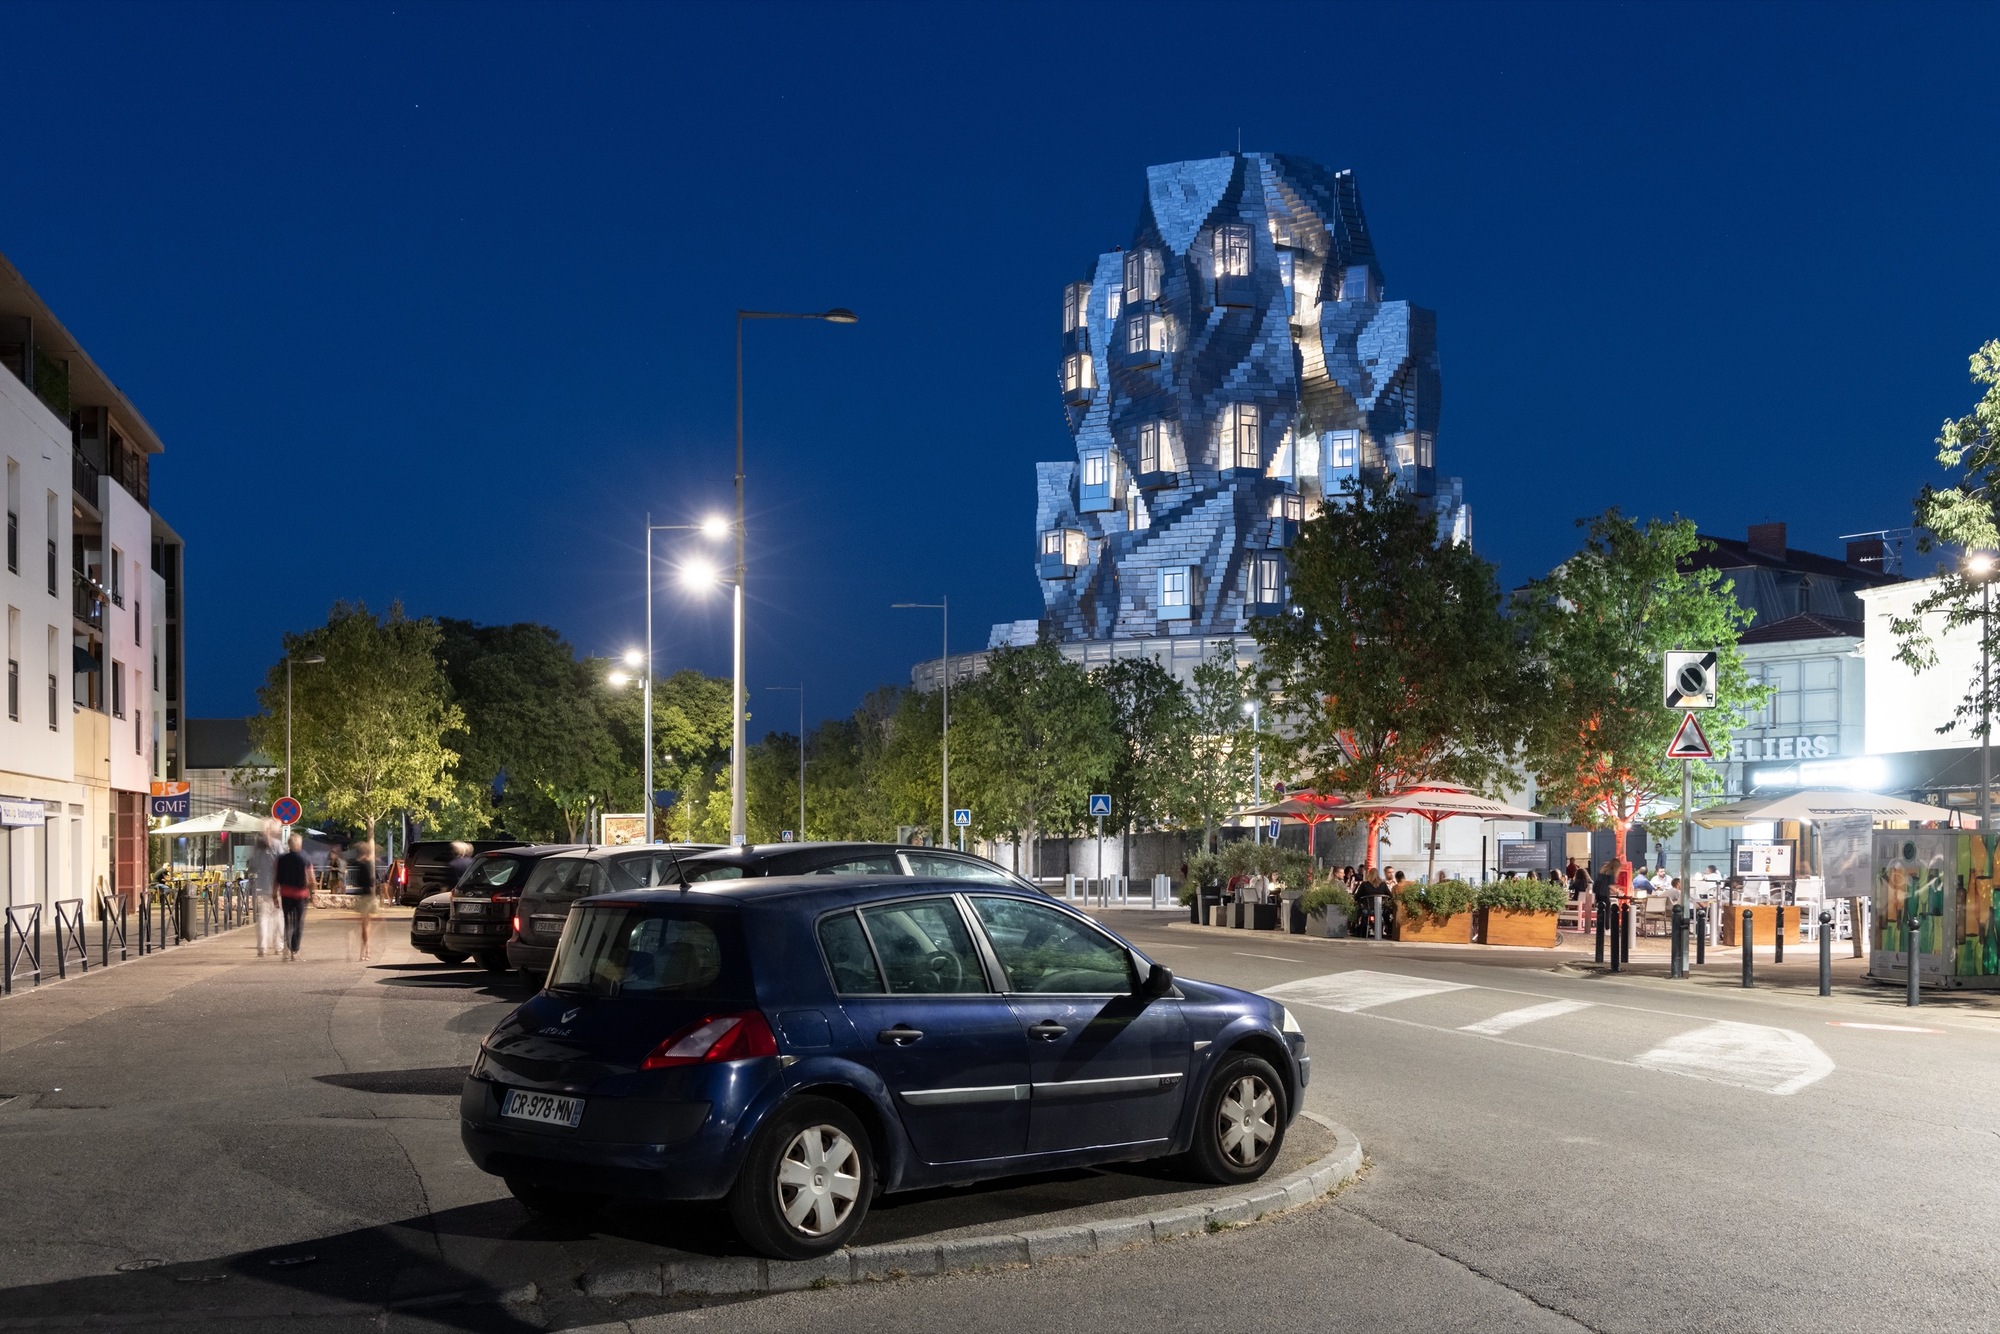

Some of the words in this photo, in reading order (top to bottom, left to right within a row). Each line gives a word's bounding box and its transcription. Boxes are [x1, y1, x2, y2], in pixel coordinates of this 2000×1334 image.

[1708, 736, 1829, 761] ELIERS
[154, 800, 187, 813] GMF
[511, 1093, 575, 1122] CR-978-MN
